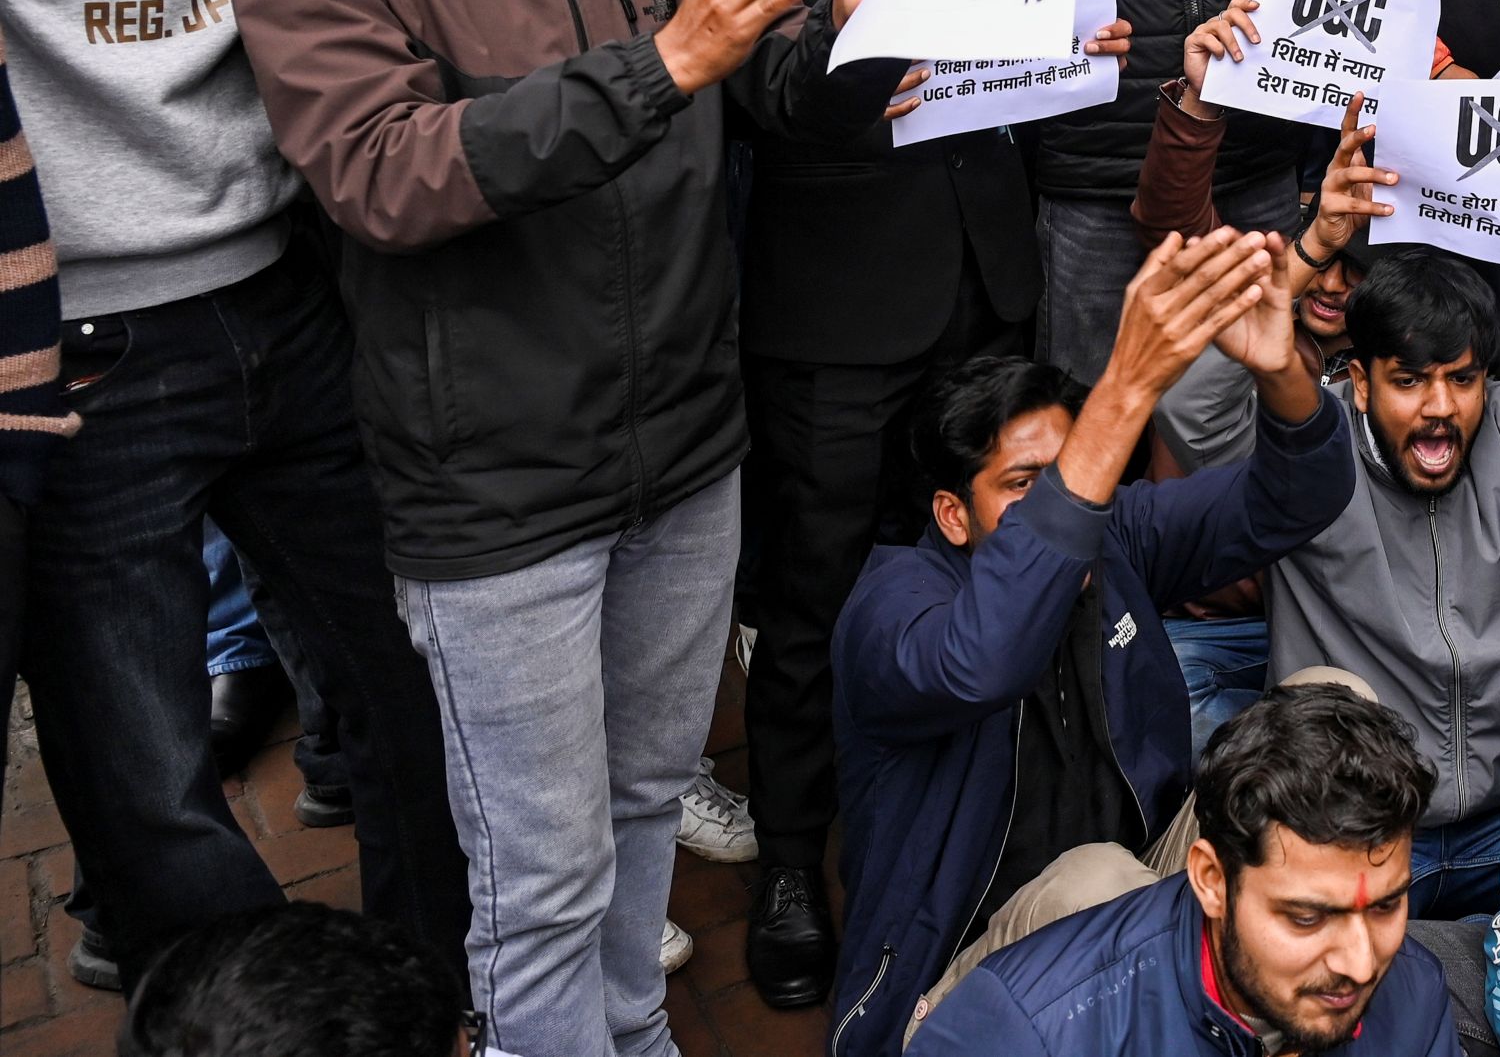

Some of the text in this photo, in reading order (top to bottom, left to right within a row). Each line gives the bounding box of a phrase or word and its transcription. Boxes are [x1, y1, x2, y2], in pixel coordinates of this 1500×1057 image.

[84, 0, 173, 44] REG.
[1271, 37, 1342, 72] शिक्षा में
[923, 58, 1091, 102] UGC की मनमानी नहीं चलेगी
[1257, 67, 1319, 101] देश का
[1421, 187, 1458, 205] UGC
[1462, 193, 1496, 212] होश
[1418, 204, 1473, 229] विरोधी
[1114, 612, 1131, 632] THE
[1108, 623, 1134, 648] NORTH
[1119, 629, 1137, 648] FACE
